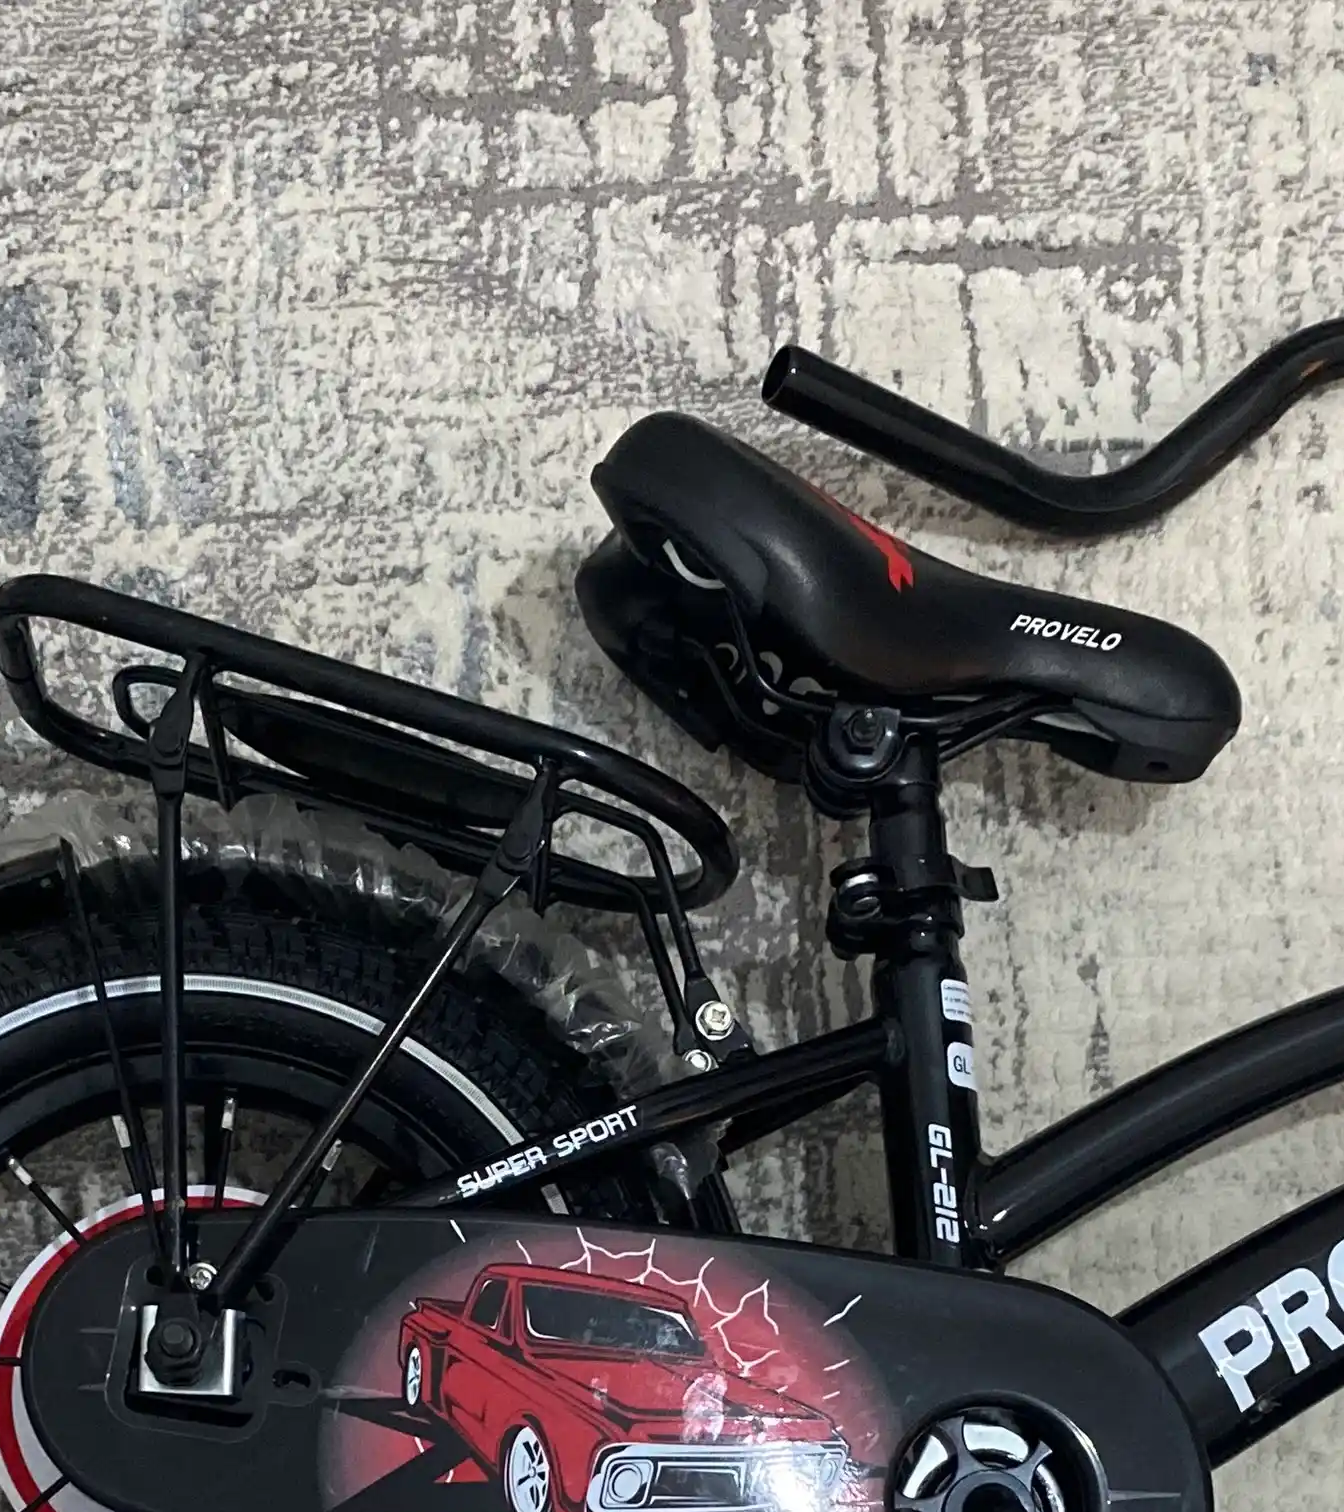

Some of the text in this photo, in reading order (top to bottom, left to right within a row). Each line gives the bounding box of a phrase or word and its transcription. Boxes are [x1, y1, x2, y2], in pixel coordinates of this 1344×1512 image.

[1010, 613, 1121, 652] PROVELO
[457, 1105, 637, 1198] SUPER SPORT
[928, 1123, 960, 1244] GL-212
